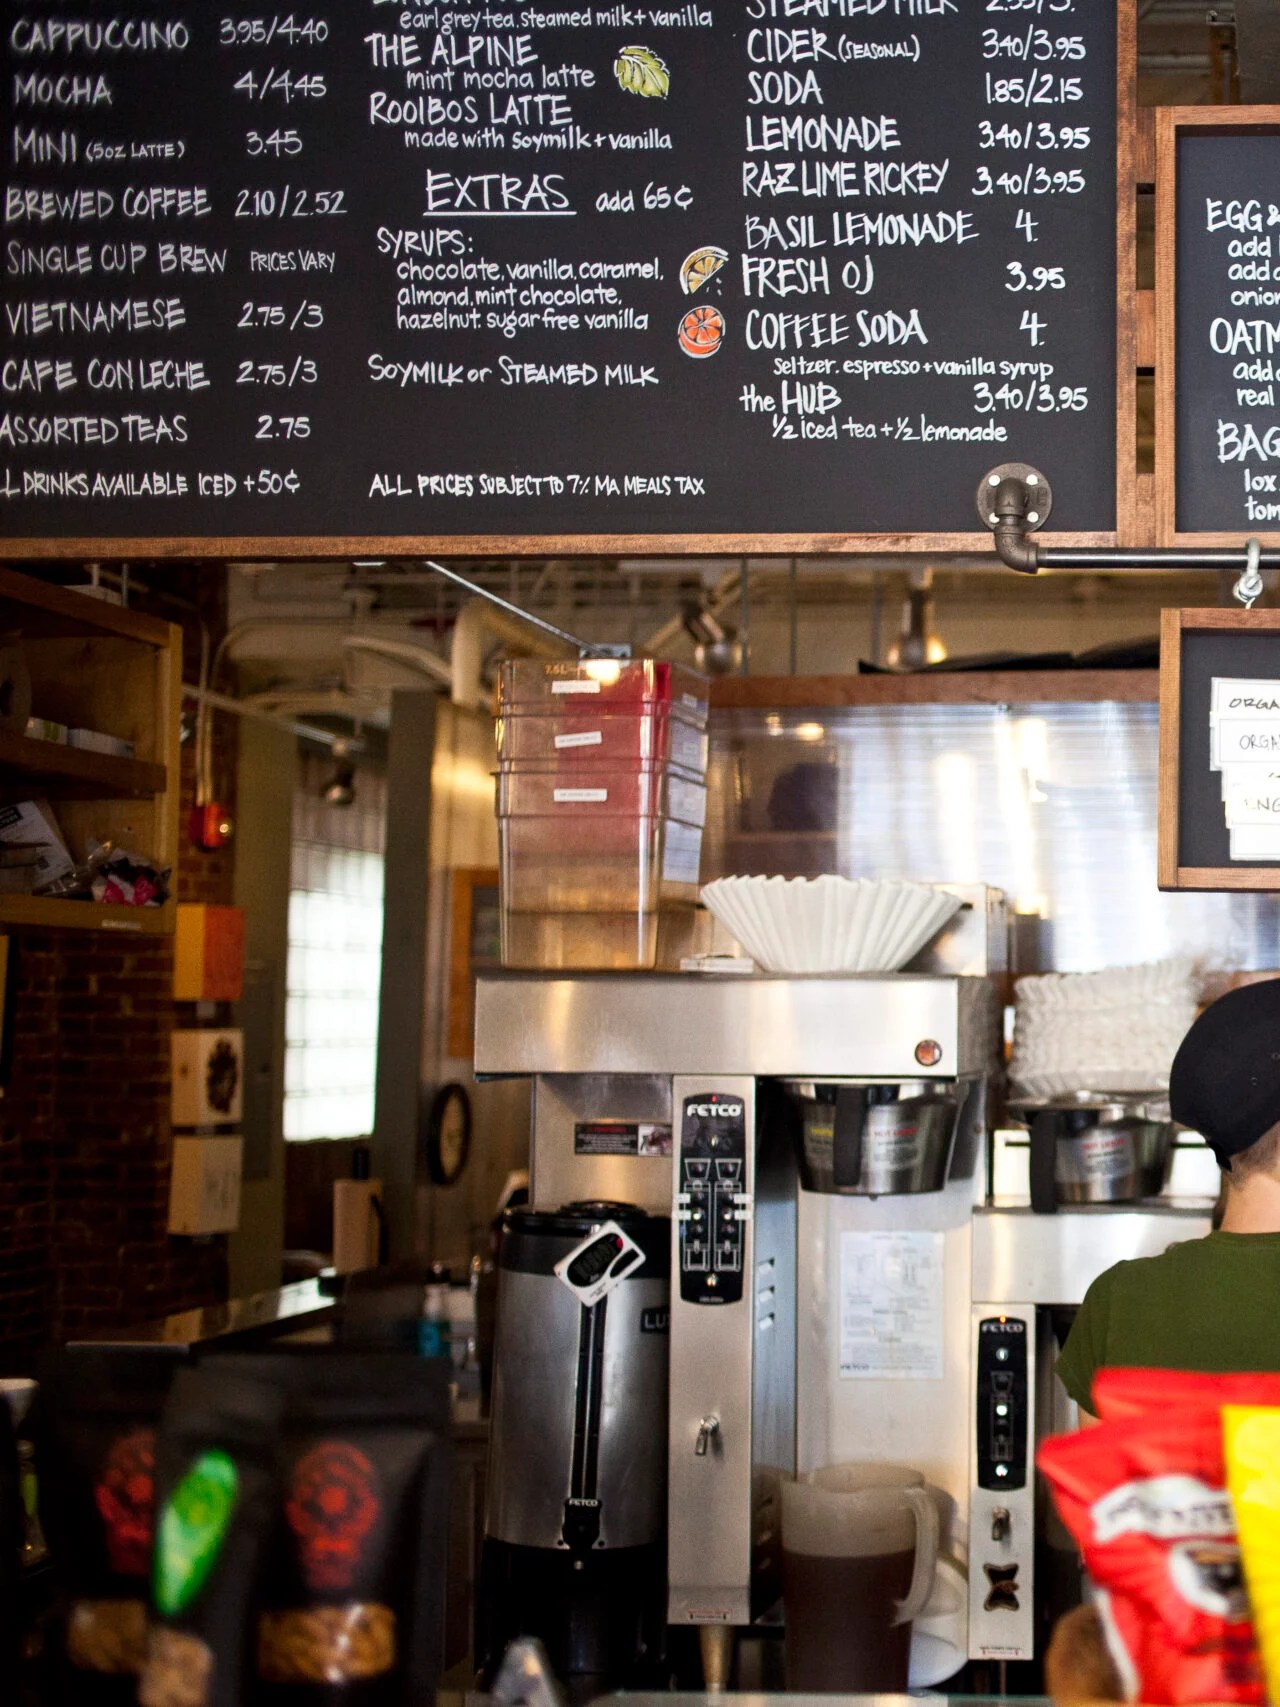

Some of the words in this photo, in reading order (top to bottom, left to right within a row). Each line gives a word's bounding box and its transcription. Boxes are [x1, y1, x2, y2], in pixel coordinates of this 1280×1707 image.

[12, 20, 188, 51] CAPPUCCINO
[364, 33, 421, 67] THE
[431, 34, 538, 68] ALPINE
[747, 28, 837, 63] CIDER
[838, 34, 920, 62] (SEASONAL)
[15, 74, 112, 104] MOCHA
[407, 67, 455, 91] mint
[464, 67, 534, 89] mocha
[542, 64, 595, 88] latte
[748, 70, 823, 105] SODA
[370, 92, 478, 125] ROOIBOS
[490, 93, 572, 125] LATTE
[14, 126, 76, 163] MINI
[247, 129, 302, 157] 3.45
[746, 114, 901, 152] LEMONADE
[426, 169, 569, 210] EXTRAS
[596, 190, 634, 212] add
[743, 161, 799, 197] RAZ
[802, 160, 860, 197] LIME
[864, 159, 949, 196] RICKEY
[6, 187, 113, 221] BREWED
[123, 186, 211, 219] COFFEE
[1206, 198, 1262, 233] EGG
[377, 227, 473, 258] SYRUPS:
[745, 215, 826, 250] BASIL
[833, 211, 979, 246] LEMONADE
[1228, 236, 1271, 257] add
[8, 241, 92, 274] SINGLE
[101, 242, 147, 274] CUP
[159, 243, 226, 273] BREW
[251, 251, 296, 271] PRICES
[298, 249, 335, 272] VARY
[742, 254, 830, 297] FRESH
[842, 255, 873, 294] OJ
[1005, 262, 1065, 291] 3.95
[6, 298, 186, 334] VIETNAMESE
[487, 310, 540, 338] sugar
[542, 308, 580, 330] free
[584, 308, 648, 329] vanilla
[746, 309, 849, 350] COFFEE
[856, 309, 928, 347] SODA
[2, 359, 77, 392] CAFE
[88, 358, 133, 390] CON
[140, 360, 210, 390] LECHE
[499, 356, 598, 385] STEAMED
[605, 364, 659, 386] MILK
[739, 384, 776, 412] the
[782, 380, 842, 415] HUB
[1237, 385, 1274, 406] real
[0, 414, 119, 446] ASSORTED
[121, 414, 187, 443] TEAS
[255, 415, 310, 439] 2.75
[23, 471, 89, 495] DRINKS
[92, 472, 188, 497] AVAILABLE
[199, 473, 236, 497] ICED
[369, 474, 412, 497] ALL
[418, 474, 473, 496] PRICES
[479, 474, 542, 496] SUBJECT
[624, 475, 671, 496] MEALS
[674, 476, 705, 495] TAX
[687, 1103, 743, 1117] FETCO
